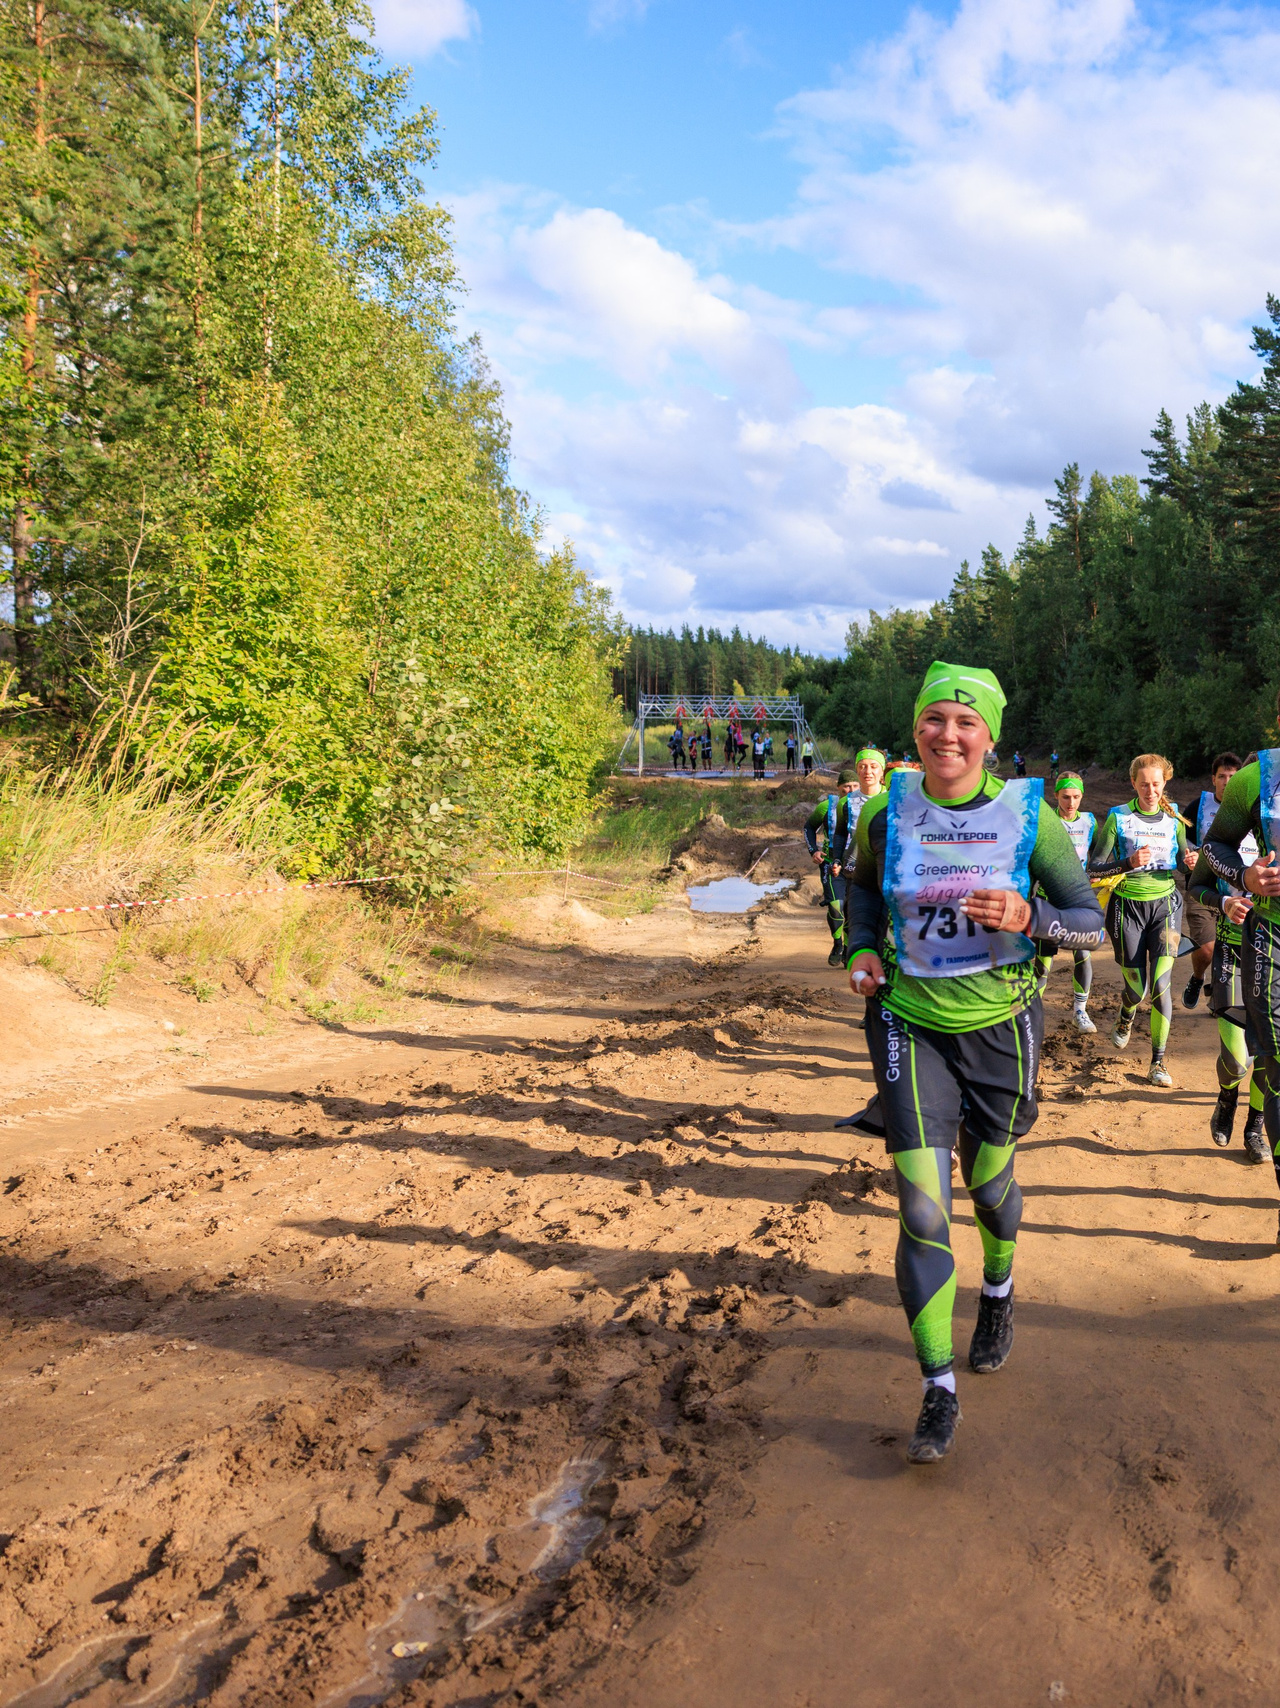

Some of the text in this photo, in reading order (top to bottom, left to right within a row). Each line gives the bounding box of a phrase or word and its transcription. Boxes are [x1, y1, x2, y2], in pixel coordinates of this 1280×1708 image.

[914, 809, 929, 827] 1
[920, 832, 998, 842] ГОНКА ГЕРОЕВ
[914, 864, 989, 877] Greenway
[918, 906, 998, 940] 731
[946, 952, 990, 964] ГАЗПРОМБАНК
